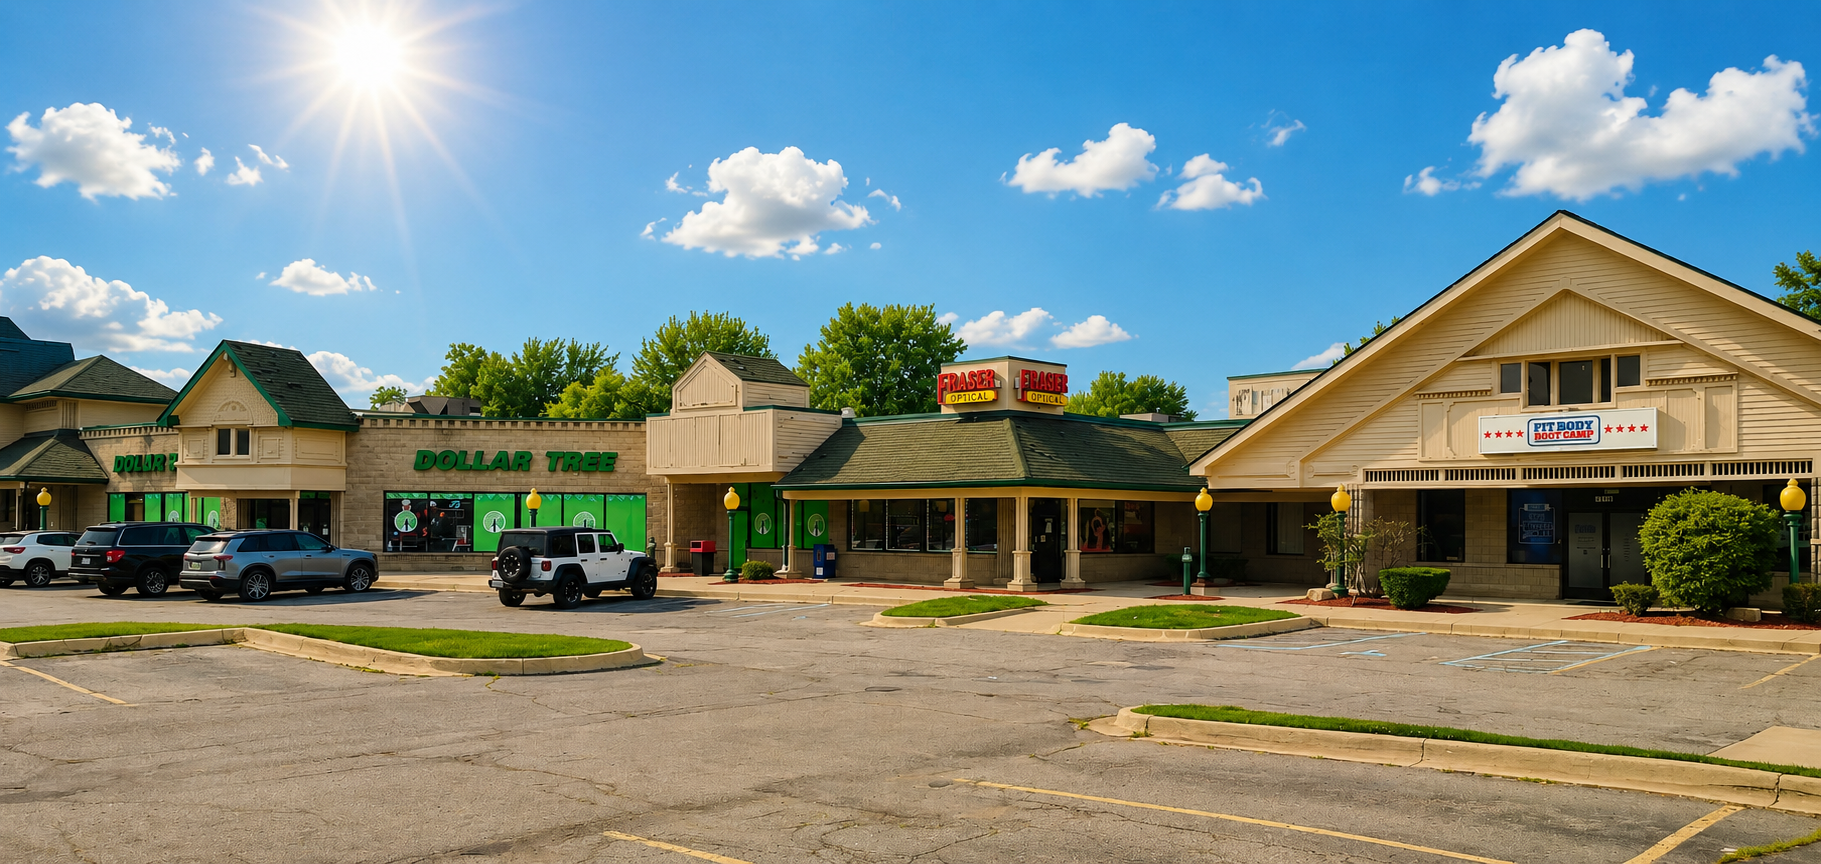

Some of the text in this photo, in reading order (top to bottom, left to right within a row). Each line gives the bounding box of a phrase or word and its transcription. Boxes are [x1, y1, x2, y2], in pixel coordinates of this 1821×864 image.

[938, 369, 995, 398] FRASER
[951, 392, 988, 402] OPTICAL
[1031, 393, 1064, 404] OPTICAL
[1557, 420, 1594, 431] BODY
[1563, 430, 1594, 438] CAMP
[413, 449, 618, 472] DOLLAR TREE
